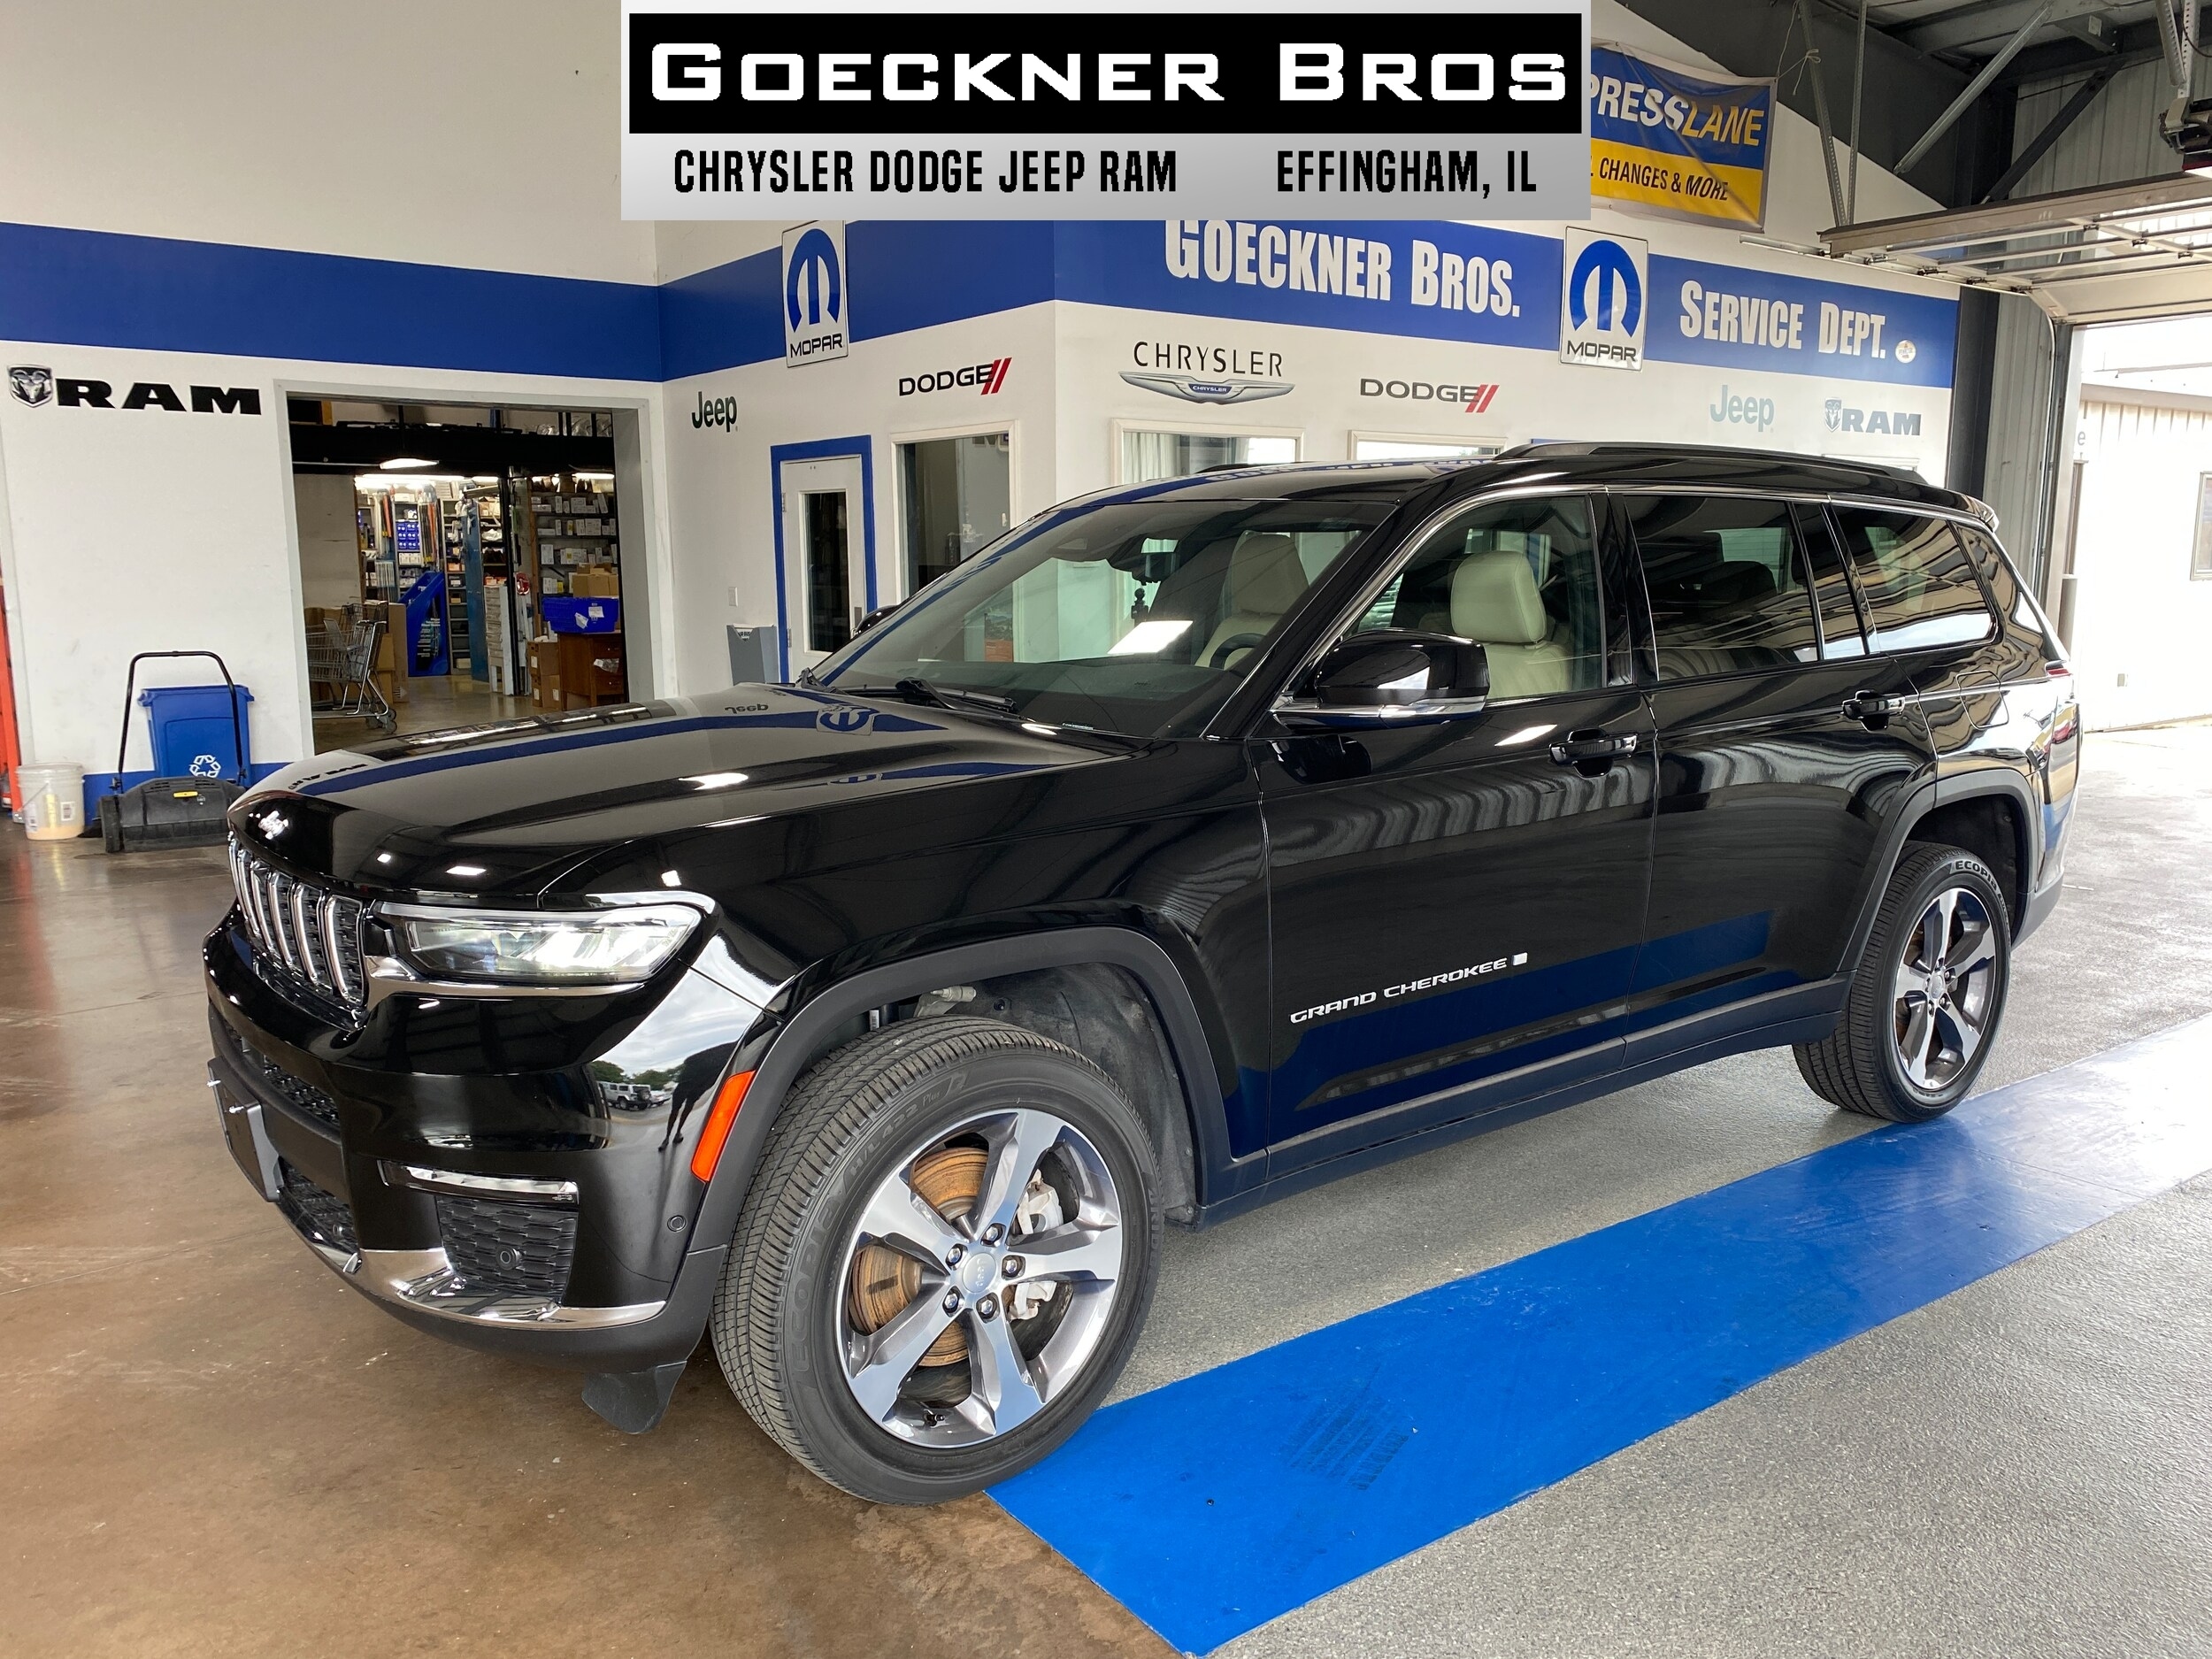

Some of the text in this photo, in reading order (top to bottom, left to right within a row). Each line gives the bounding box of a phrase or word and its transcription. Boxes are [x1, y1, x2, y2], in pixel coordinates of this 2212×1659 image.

[1600, 157, 1667, 189] CHANGES
[1671, 173, 1681, 193] &
[1686, 175, 1728, 201] MORE
[1164, 220, 1520, 317] GOECKNER BROS.
[1680, 280, 1886, 359] SERVICE DEPT.
[790, 333, 842, 358] MOPAR
[1133, 342, 1283, 377] CHRYSLER
[1567, 340, 1636, 362] MOPAR
[56, 378, 261, 415] RAM
[899, 364, 993, 396] DODGE
[1360, 379, 1479, 403] DODGE
[692, 391, 737, 433] Jeep
[1710, 385, 1774, 432] Jeep
[1841, 409, 1921, 436] RAM
[1290, 957, 1508, 1024] GRAND CHEROKEE
[882, 1103, 918, 1139] 422
[922, 1091, 941, 1107] Plus
